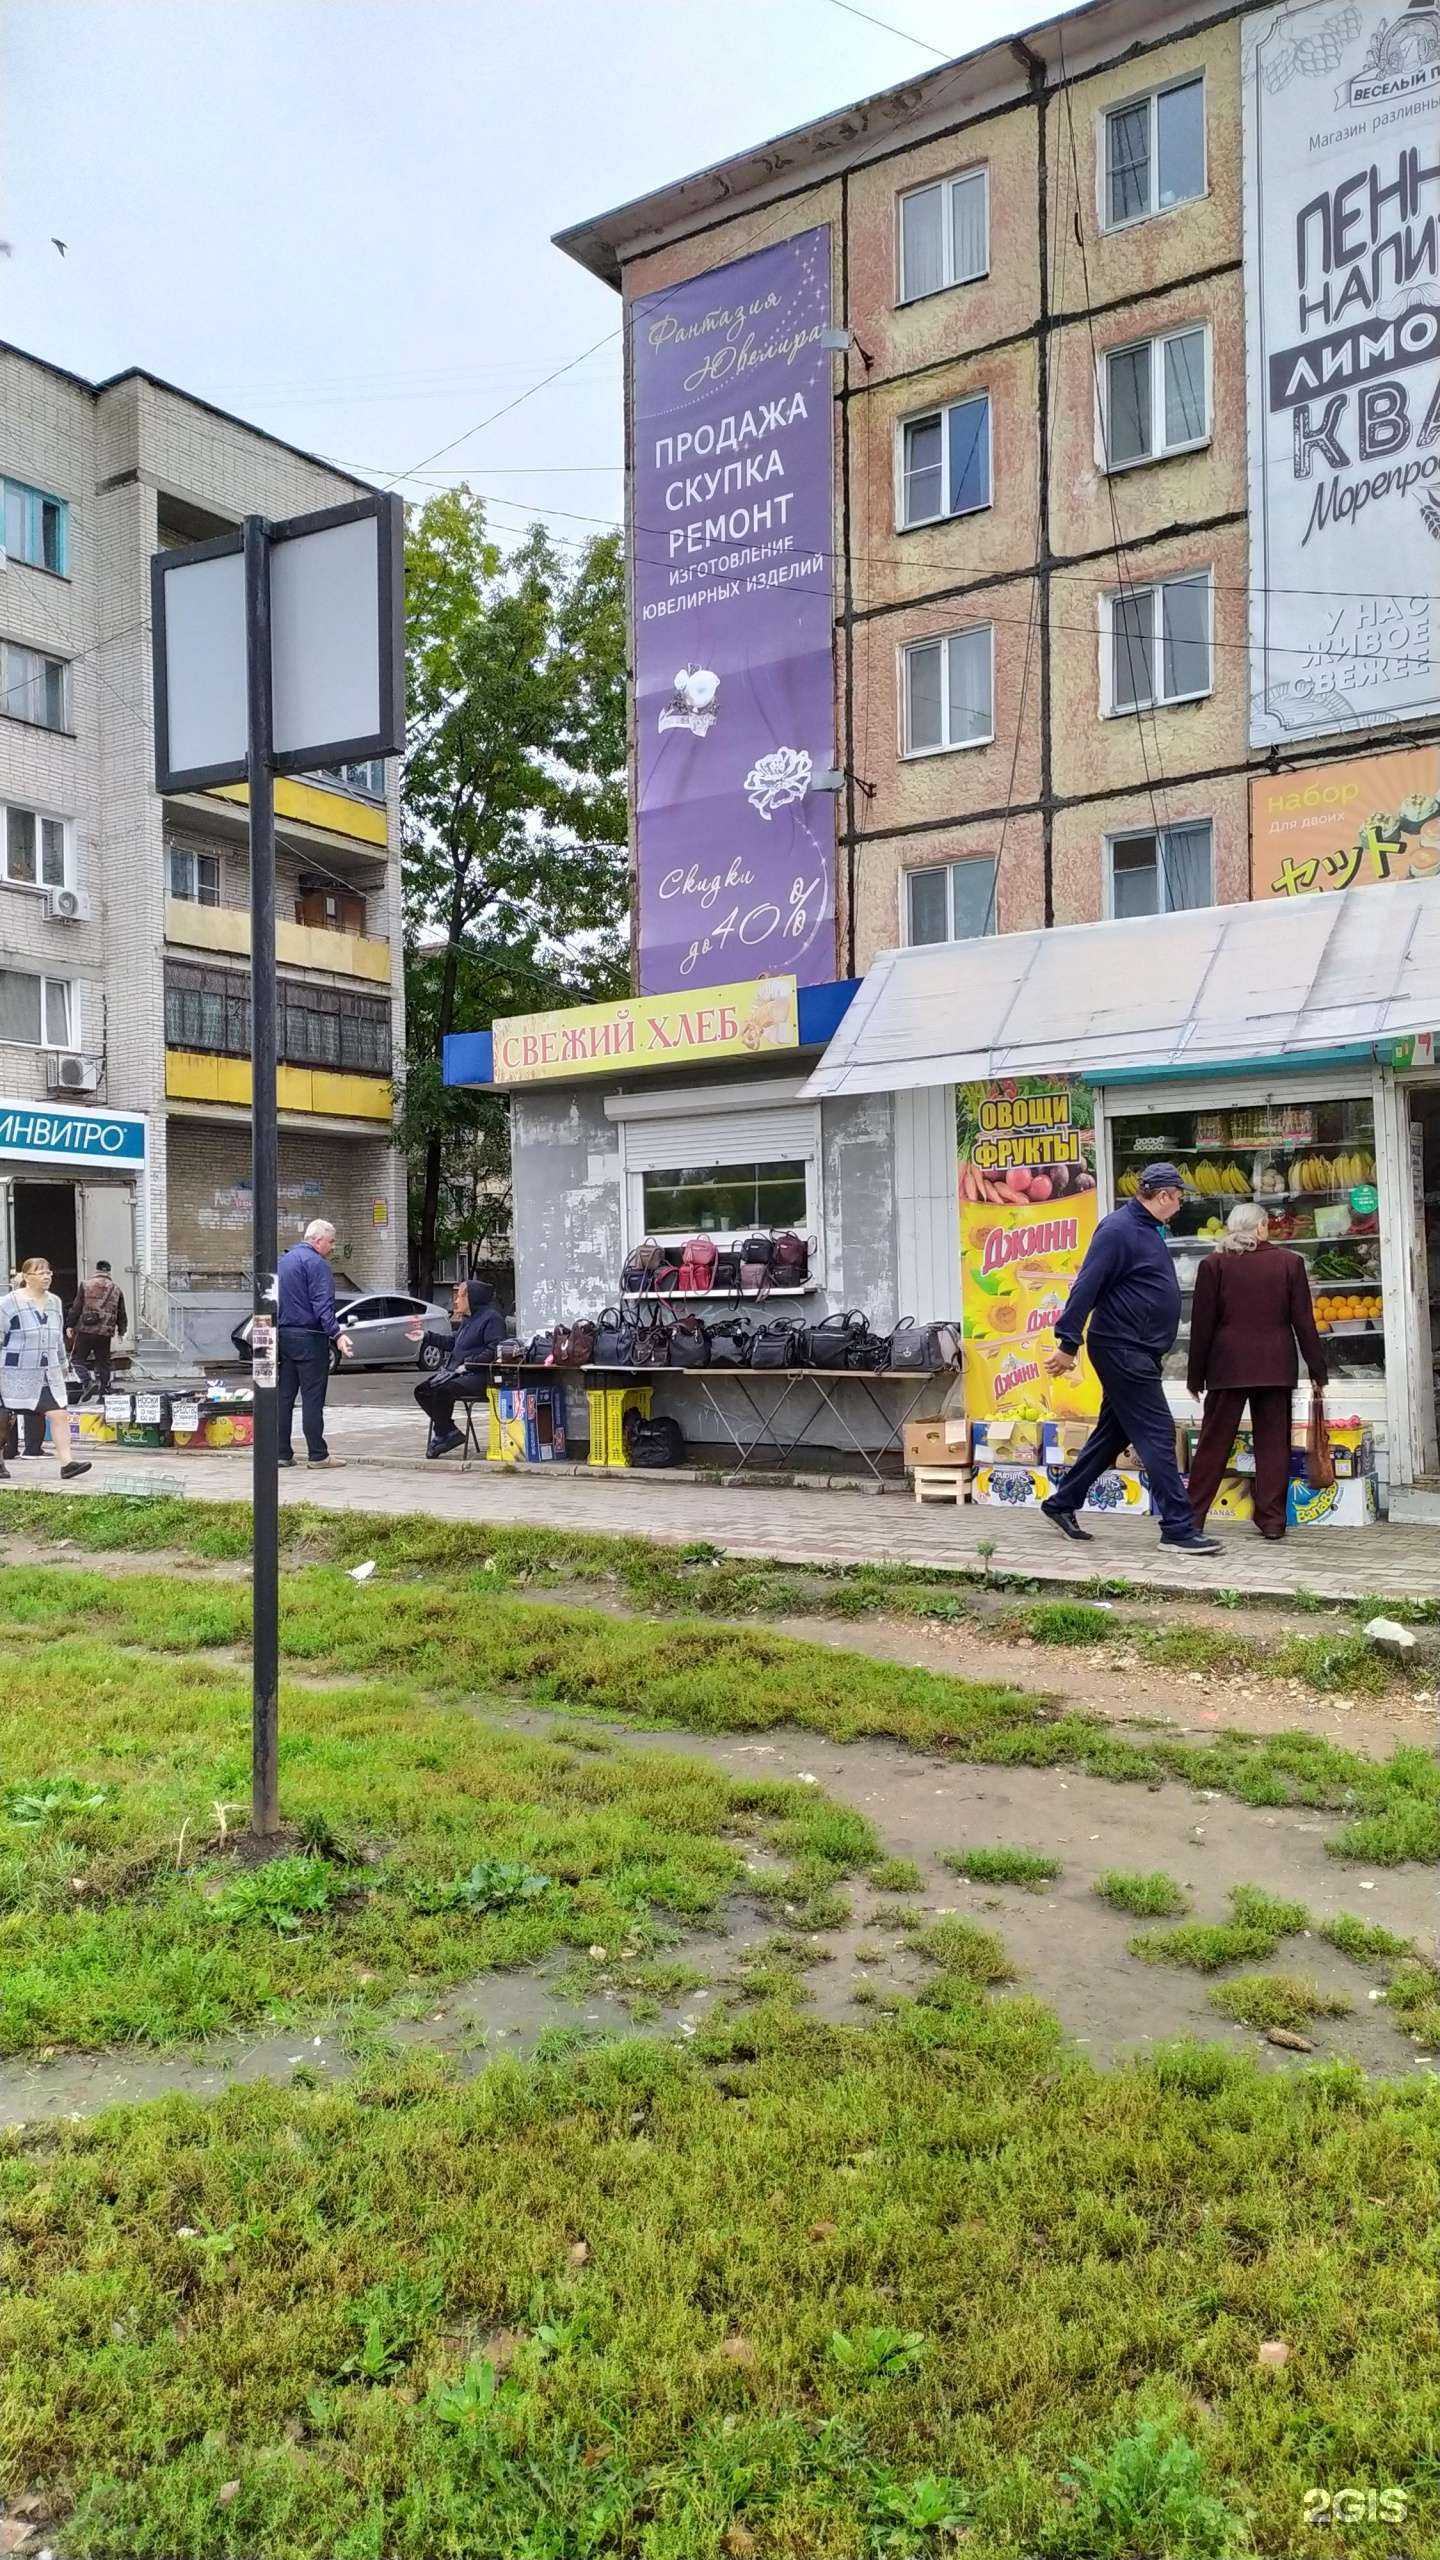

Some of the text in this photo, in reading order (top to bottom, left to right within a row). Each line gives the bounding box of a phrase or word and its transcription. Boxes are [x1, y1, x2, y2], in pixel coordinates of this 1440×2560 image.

[1353, 67, 1425, 101] ВЕСЕЛЫЙ
[1309, 121, 1366, 152] Магазин
[649, 292, 782, 355] Фантазия
[684, 324, 823, 392] Ювелира
[1285, 312, 1438, 397] ЛИМО
[655, 391, 809, 469] ПРОДАЖА
[665, 449, 785, 512] СКУПКА
[669, 492, 794, 558] РЕМОНТ
[642, 553, 824, 621] ЮВЕЛИРНЫХ ИЗДЕЛИЙ
[669, 535, 794, 587] ИЗГОТОВЛЕНИЕ
[1326, 592, 1430, 637] У НАС
[1301, 618, 1430, 669] ЖИВОЕ
[1294, 649, 1430, 699] СВЕЖЕЕ
[1267, 780, 1360, 813] набор
[1300, 811, 1345, 829] двоих
[658, 856, 754, 909] Скидки
[1271, 826, 1407, 896] セット
[711, 877, 820, 950] 40%
[502, 1006, 739, 1069] СВЕЖИЙ ХЛЕБ
[979, 1093, 1071, 1132] ОВОЩИ
[974, 1132, 1080, 1168] ФРУКТЫ
